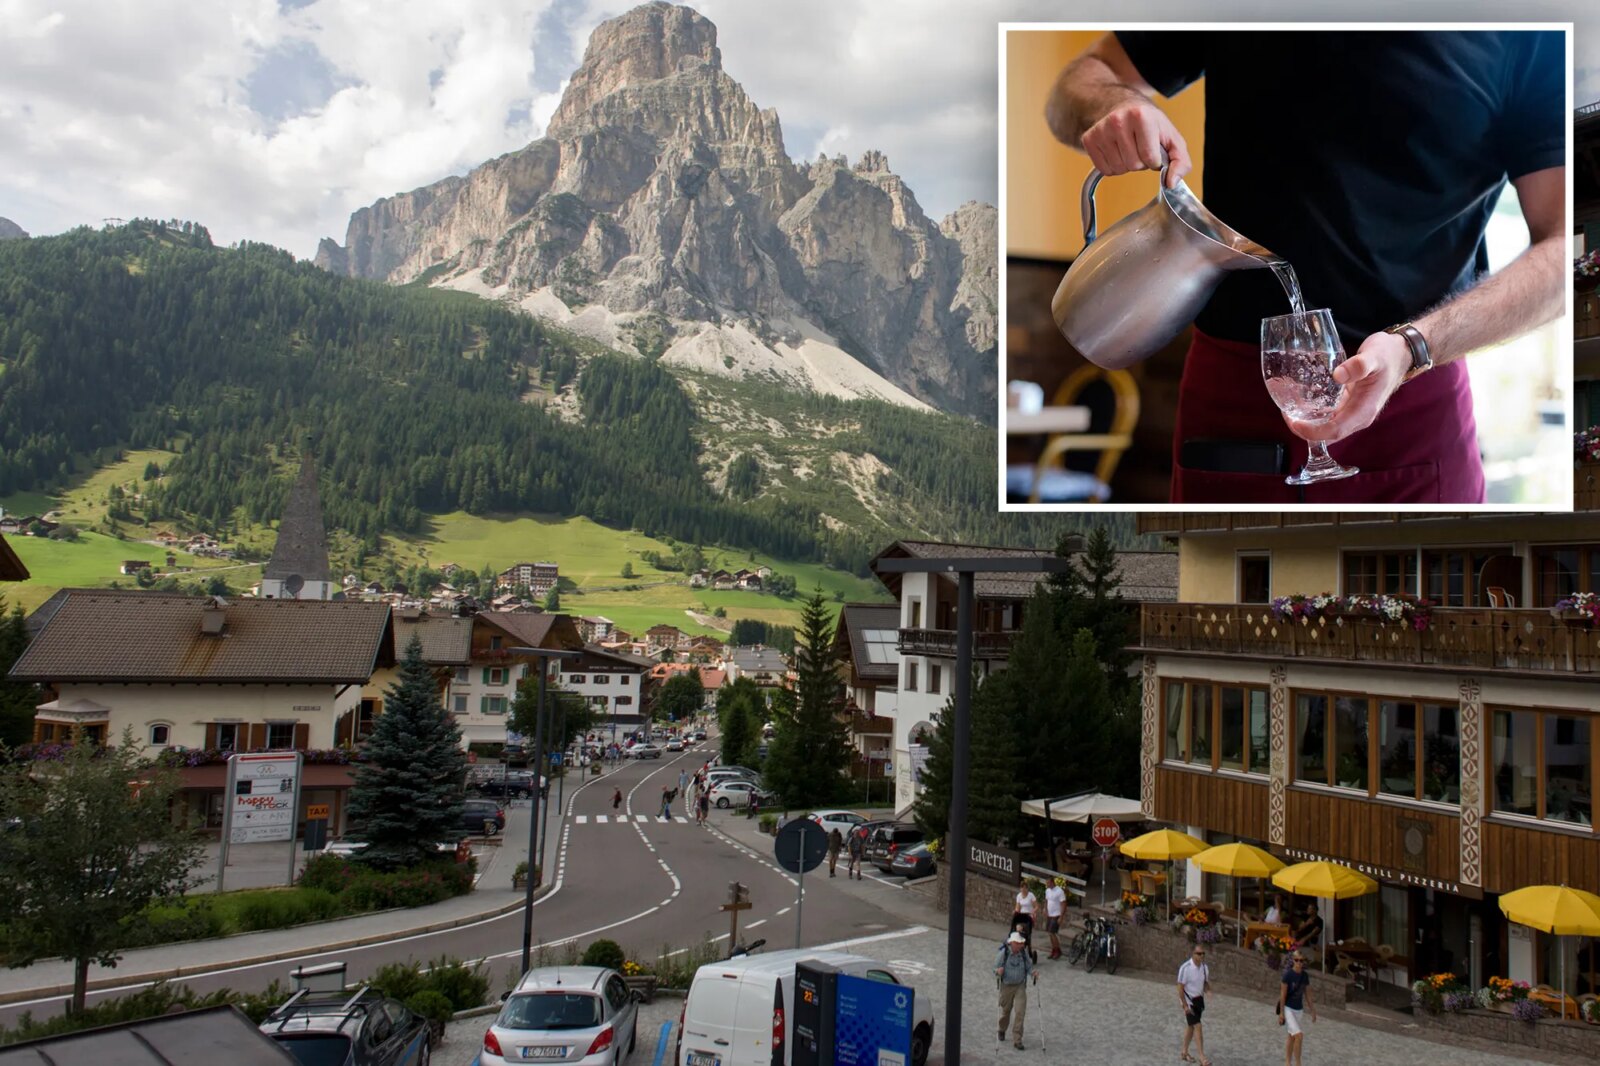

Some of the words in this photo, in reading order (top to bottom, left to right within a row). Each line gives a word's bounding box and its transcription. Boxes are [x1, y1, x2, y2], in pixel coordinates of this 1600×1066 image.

[238, 796, 274, 807] happy
[255, 802, 288, 810] STOCK
[309, 807, 328, 815] TAXI
[1094, 826, 1118, 838] STOP
[971, 845, 1013, 873] taverna
[1358, 864, 1392, 878] GRILL
[1400, 873, 1459, 893] PIZZERIA
